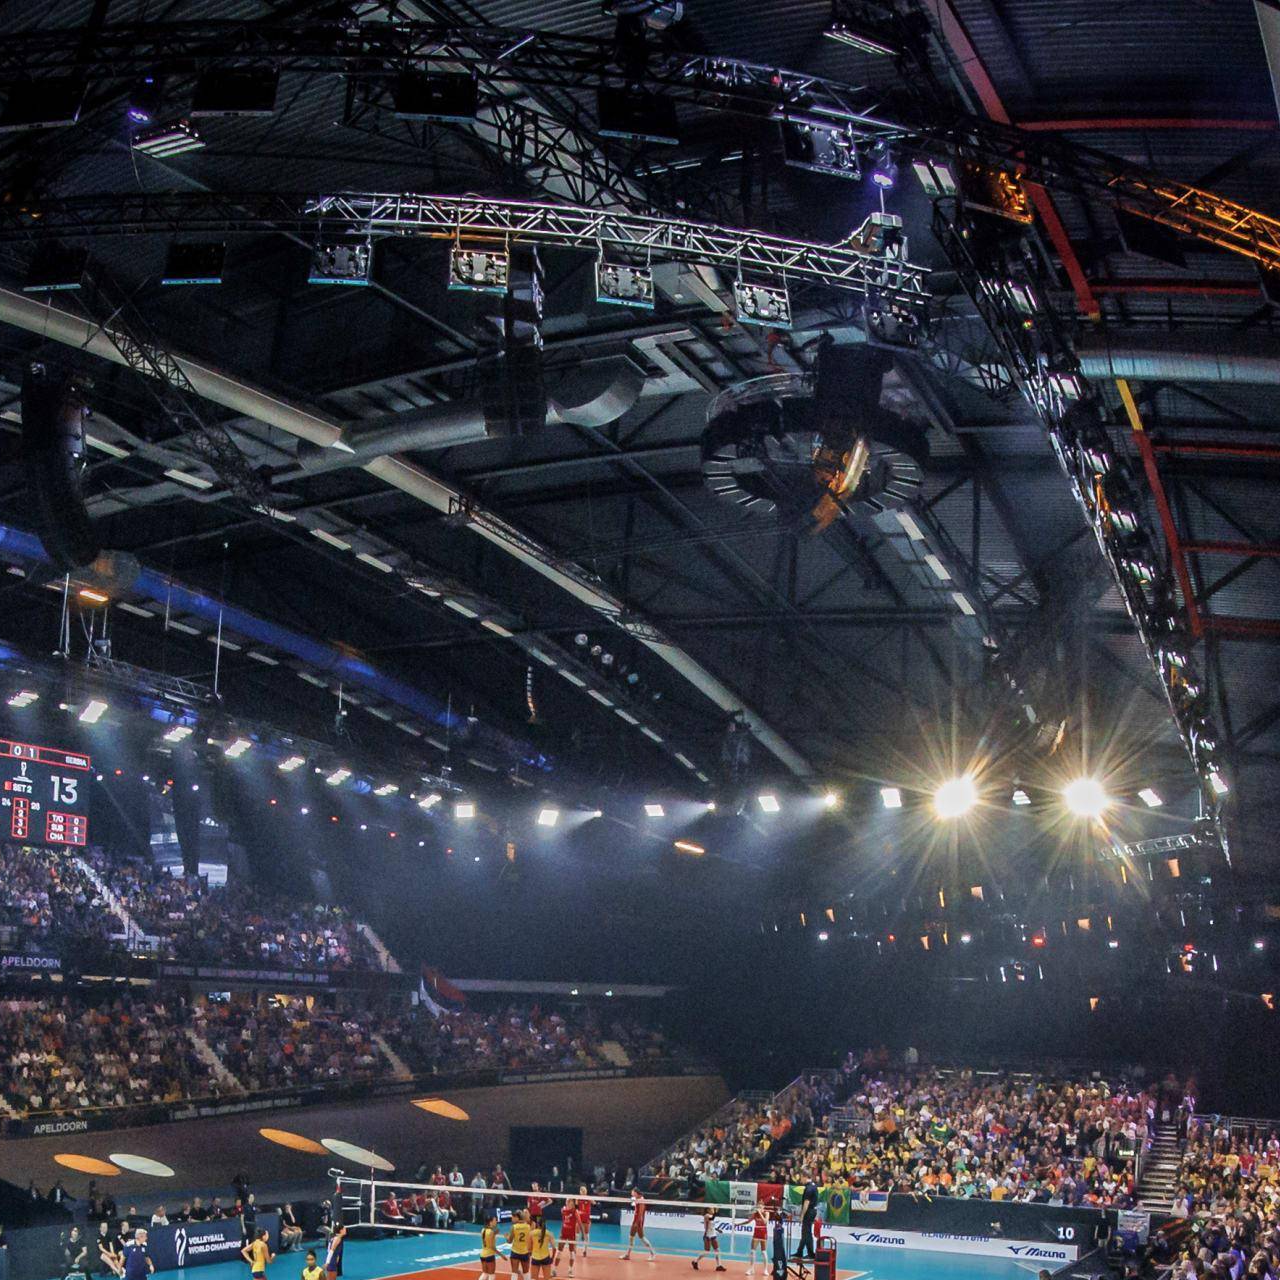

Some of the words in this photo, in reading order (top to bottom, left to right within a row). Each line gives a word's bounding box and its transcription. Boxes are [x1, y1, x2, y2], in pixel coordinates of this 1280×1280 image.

[14, 745, 22, 756] 0
[29, 748, 34, 758] 1
[13, 782, 26, 792] SET
[26, 785, 32, 793] 2
[50, 775, 78, 805] 13
[1, 955, 61, 968] APELDOORN
[34, 1121, 87, 1134] APELDOORN
[188, 1233, 225, 1245] VOLLEYBALL
[1058, 1227, 1074, 1240] 10
[188, 1245, 210, 1255] WORLD
